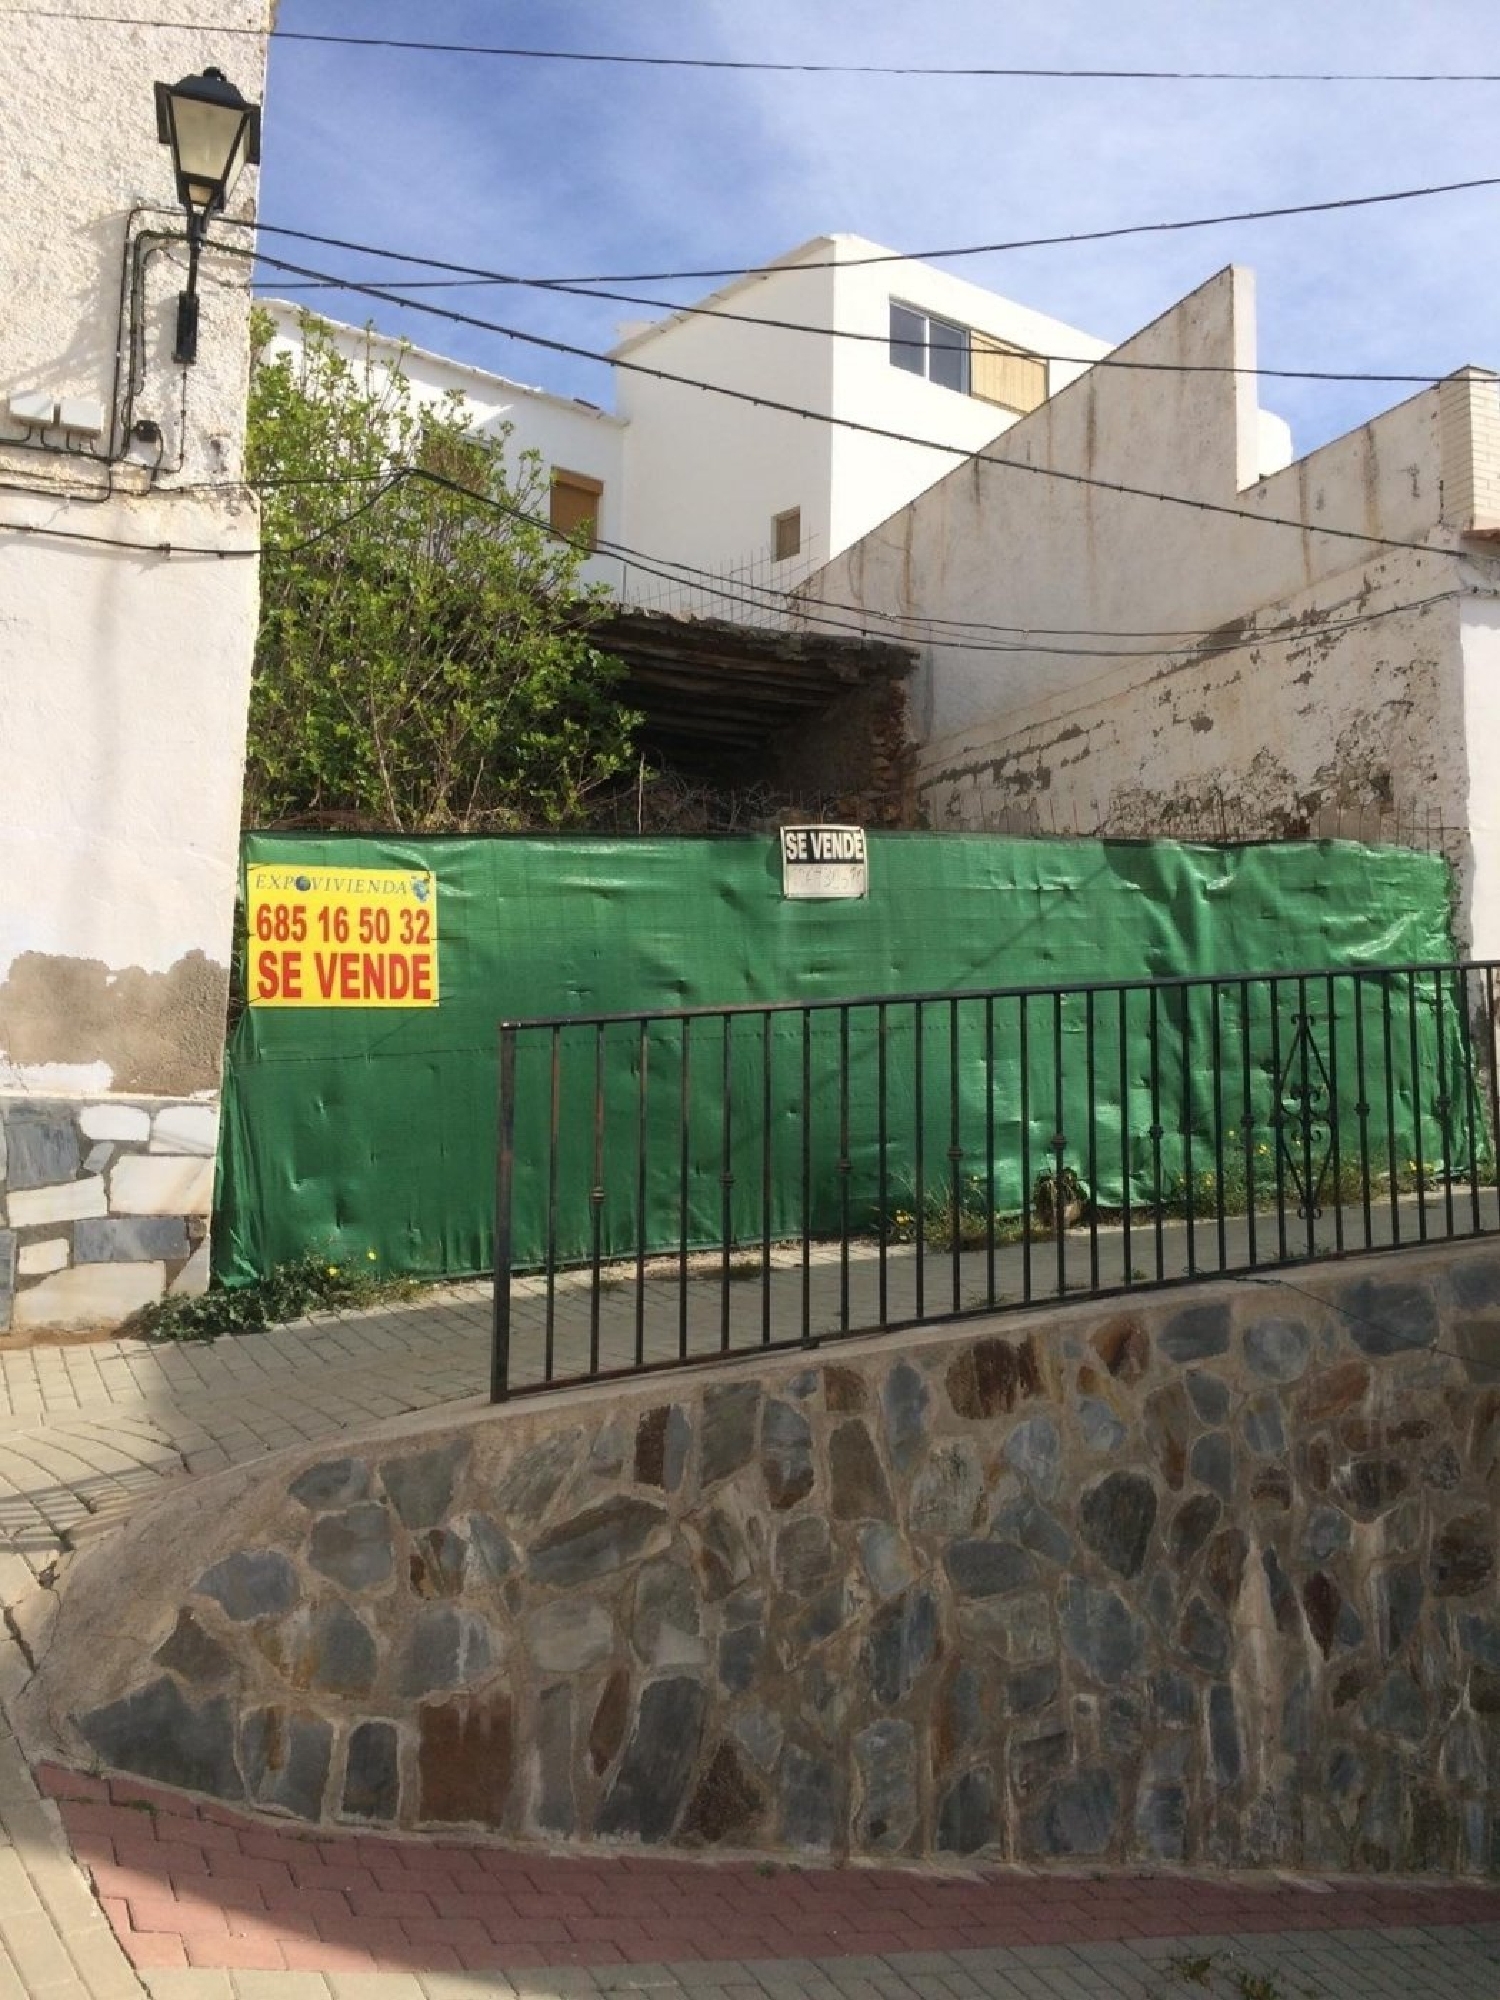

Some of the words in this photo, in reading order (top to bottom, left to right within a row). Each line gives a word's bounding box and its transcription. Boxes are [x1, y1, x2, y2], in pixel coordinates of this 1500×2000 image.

[786, 832, 807, 860] SE
[810, 832, 863, 860] VENDE
[256, 903, 307, 941] 685
[318, 905, 349, 943] 16
[359, 907, 389, 944] 50
[400, 908, 430, 945] 32
[257, 950, 302, 999] SE
[313, 951, 431, 999] VENDE
